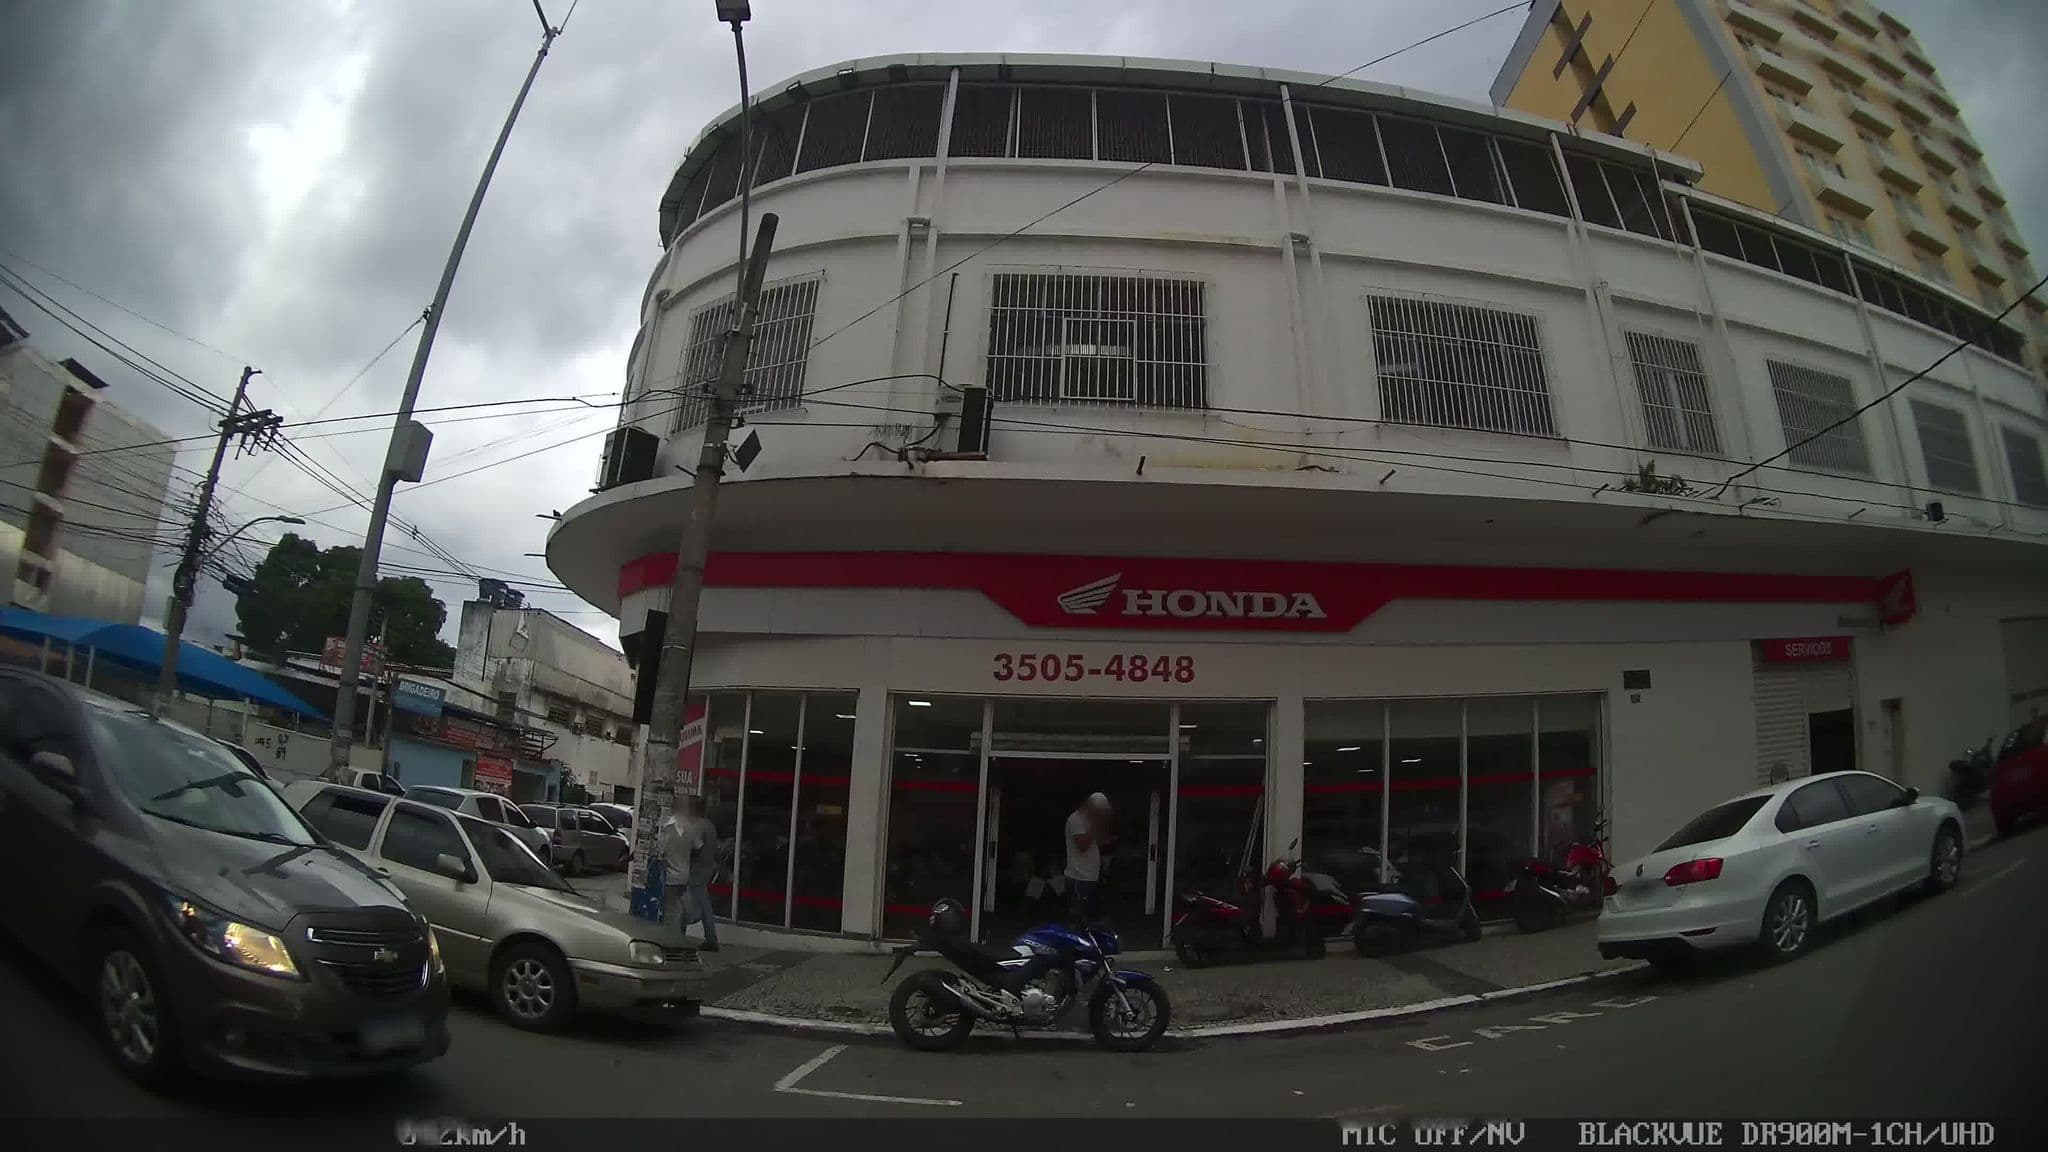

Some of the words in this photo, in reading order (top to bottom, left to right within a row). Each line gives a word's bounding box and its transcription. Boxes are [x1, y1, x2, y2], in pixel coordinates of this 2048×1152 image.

[1121, 588, 1328, 618] HONDA
[993, 653, 1195, 683] 3505-4848
[399, 680, 440, 700] BRIGADEIRO
[675, 770, 693, 784] SUA
